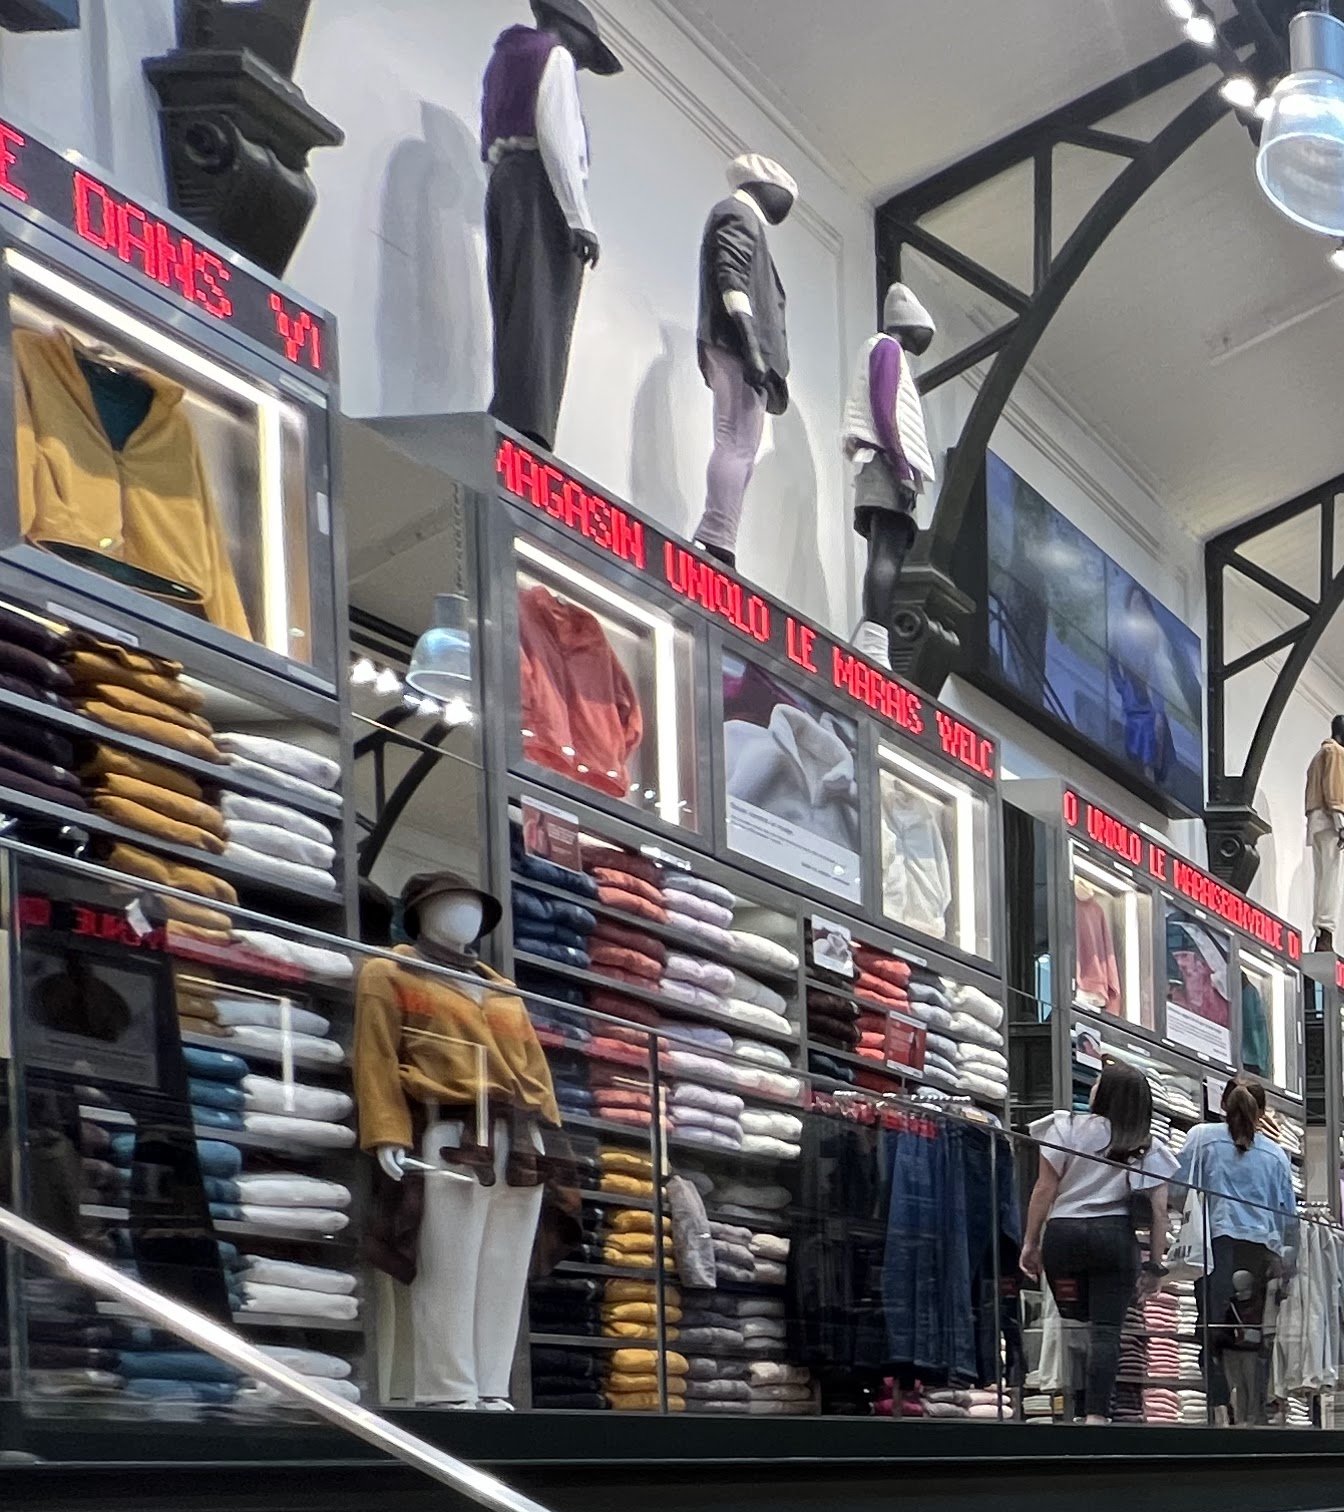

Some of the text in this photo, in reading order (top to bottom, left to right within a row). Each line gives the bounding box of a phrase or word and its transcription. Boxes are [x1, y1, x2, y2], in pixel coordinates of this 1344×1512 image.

[73, 170, 233, 319] DANS
[664, 540, 771, 643] UNIQLO
[786, 616, 818, 674] LE
[832, 645, 924, 735] MARAIS
[935, 709, 993, 779] WELC
[1149, 843, 1168, 882] LE
